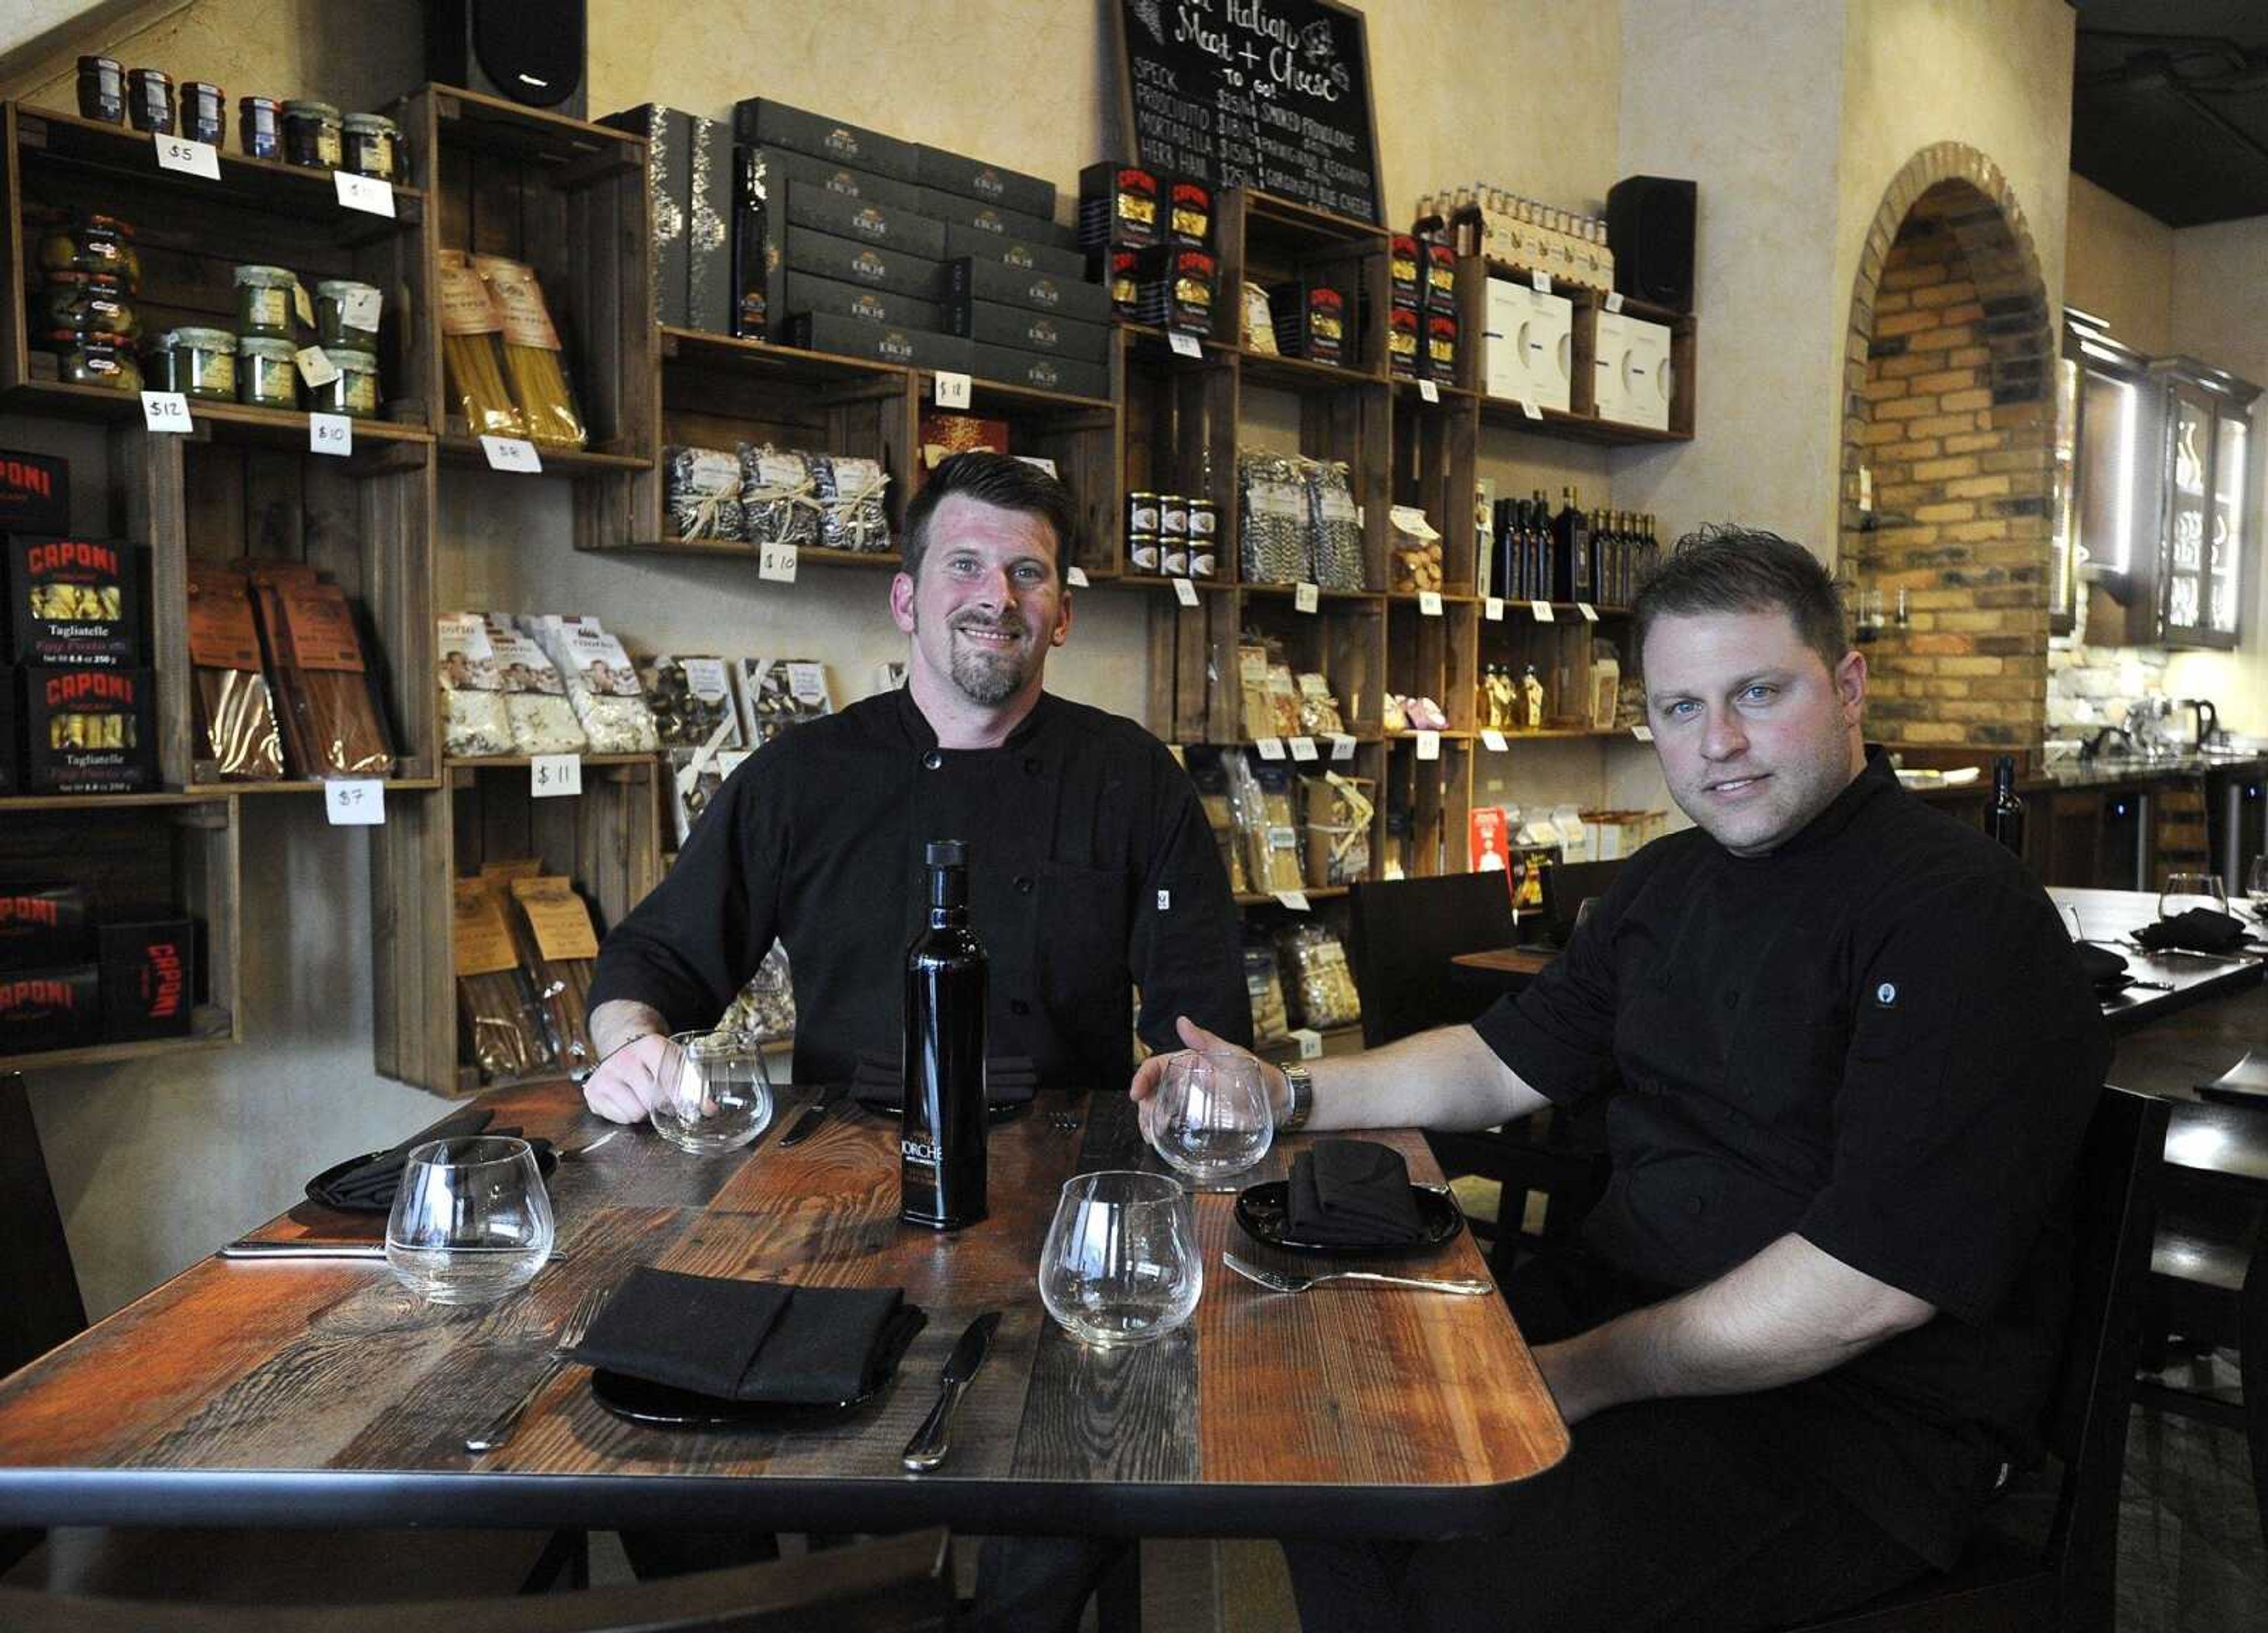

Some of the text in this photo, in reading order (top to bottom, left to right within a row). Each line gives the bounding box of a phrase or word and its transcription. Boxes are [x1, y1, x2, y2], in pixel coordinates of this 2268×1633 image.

[1175, 5, 1234, 61] Meat
[1269, 47, 1338, 102] Cheese
[1133, 57, 1178, 92] SPECK
[170, 145, 193, 161] $5
[149, 402, 182, 416] $12
[318, 428, 344, 441] $10
[28, 543, 118, 577] CAPONI
[48, 624, 109, 638] Tagliatelle
[45, 673, 135, 705] CAPONI
[148, 945, 182, 1018] CAPONI
